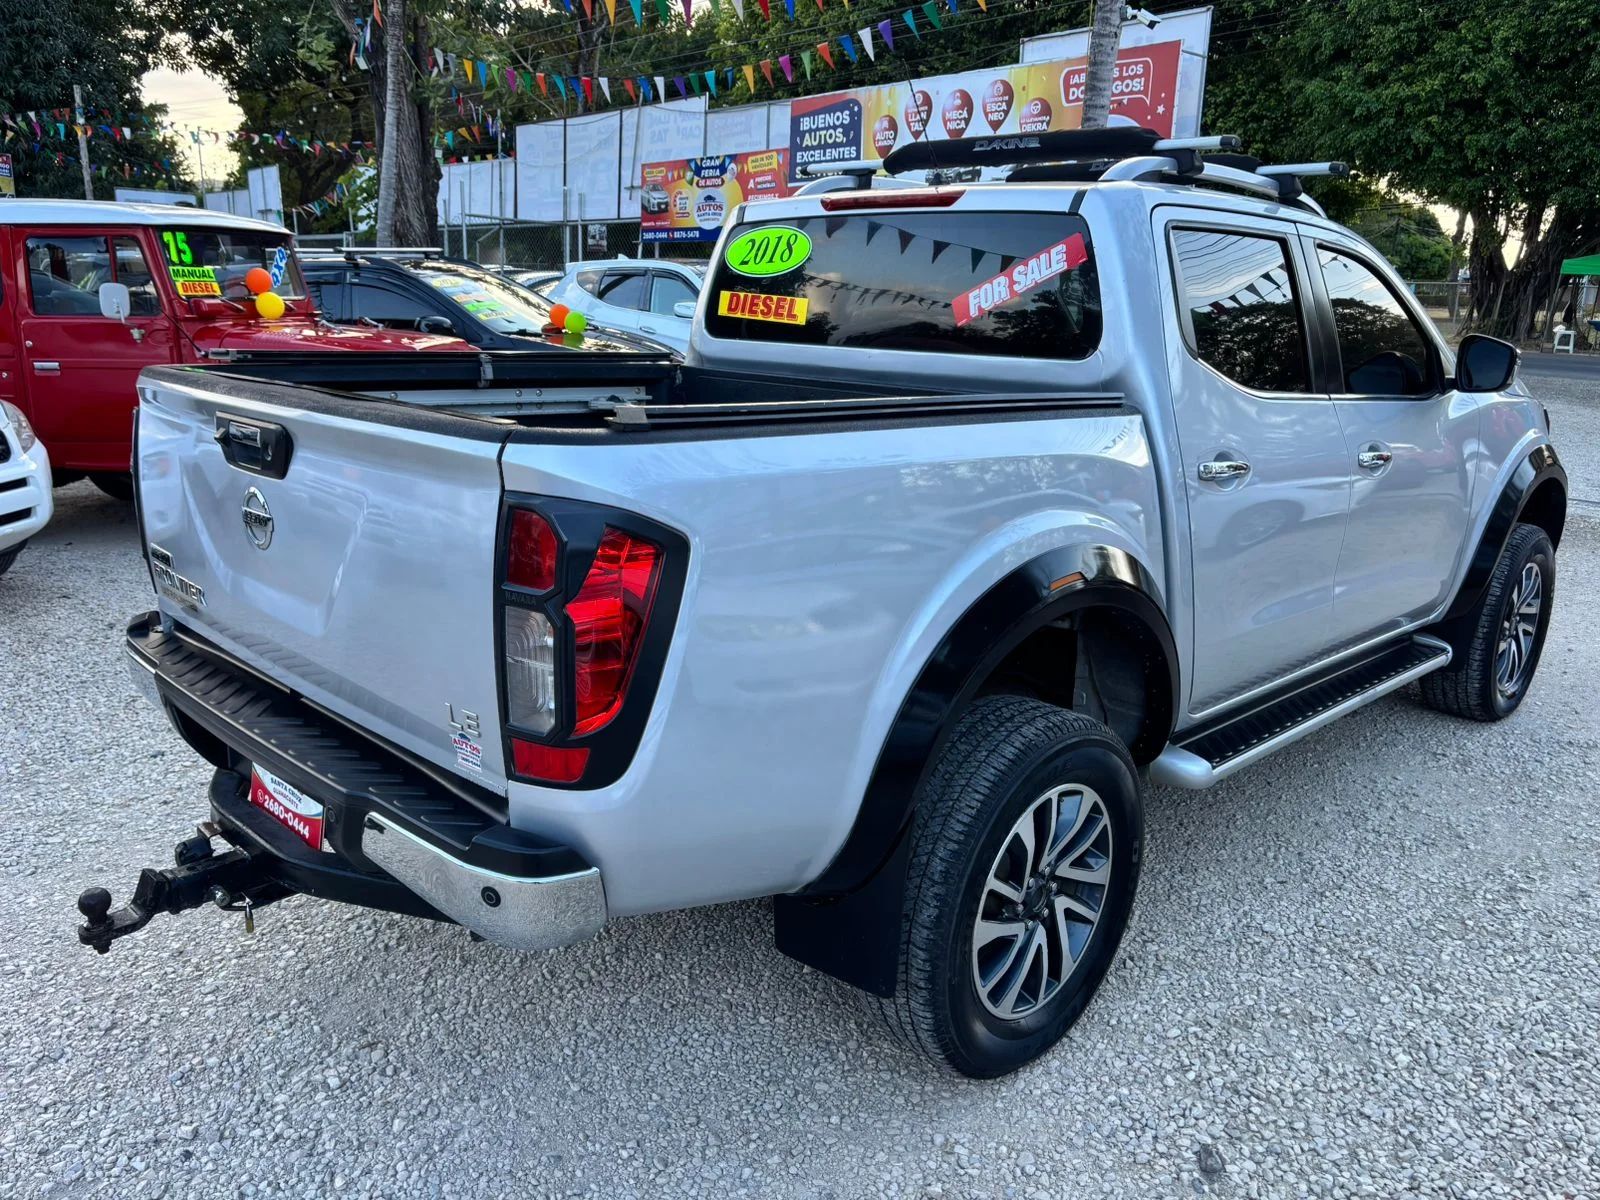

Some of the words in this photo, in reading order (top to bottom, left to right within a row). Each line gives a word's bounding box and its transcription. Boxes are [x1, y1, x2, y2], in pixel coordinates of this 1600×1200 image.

[1122, 64, 1144, 77] LOS
[1068, 77, 1145, 100] DOGOS!
[945, 107, 969, 120] MECÁ
[986, 102, 1007, 113] ESCA
[800, 110, 851, 131] ¡BUENOS
[908, 111, 927, 122] LLAN
[988, 112, 1005, 122] NEO
[910, 121, 925, 132] TAS
[946, 120, 966, 130] NICA
[1021, 122, 1048, 134] DEKRA
[802, 127, 847, 147] AUTOS,
[876, 131, 895, 140] AUTO
[875, 139, 895, 147] LAVADO
[972, 137, 1041, 152] DAKINE
[796, 146, 857, 163] EXCELENTES
[702, 159, 720, 168] GRAN
[701, 168, 720, 177] FERIA
[747, 179, 755, 189] A
[696, 203, 724, 213] AUTOS
[739, 233, 798, 266] 2018
[172, 268, 214, 279] MANUAL
[968, 275, 1011, 318] FOR
[1012, 243, 1068, 293] SALE
[181, 282, 217, 293] DIESEL
[726, 292, 798, 321] DIESEL
[453, 737, 481, 755] AUTOS
[270, 776, 288, 792] SANTA
[288, 786, 302, 804] CRUZ
[264, 794, 310, 839] 2680-0444
